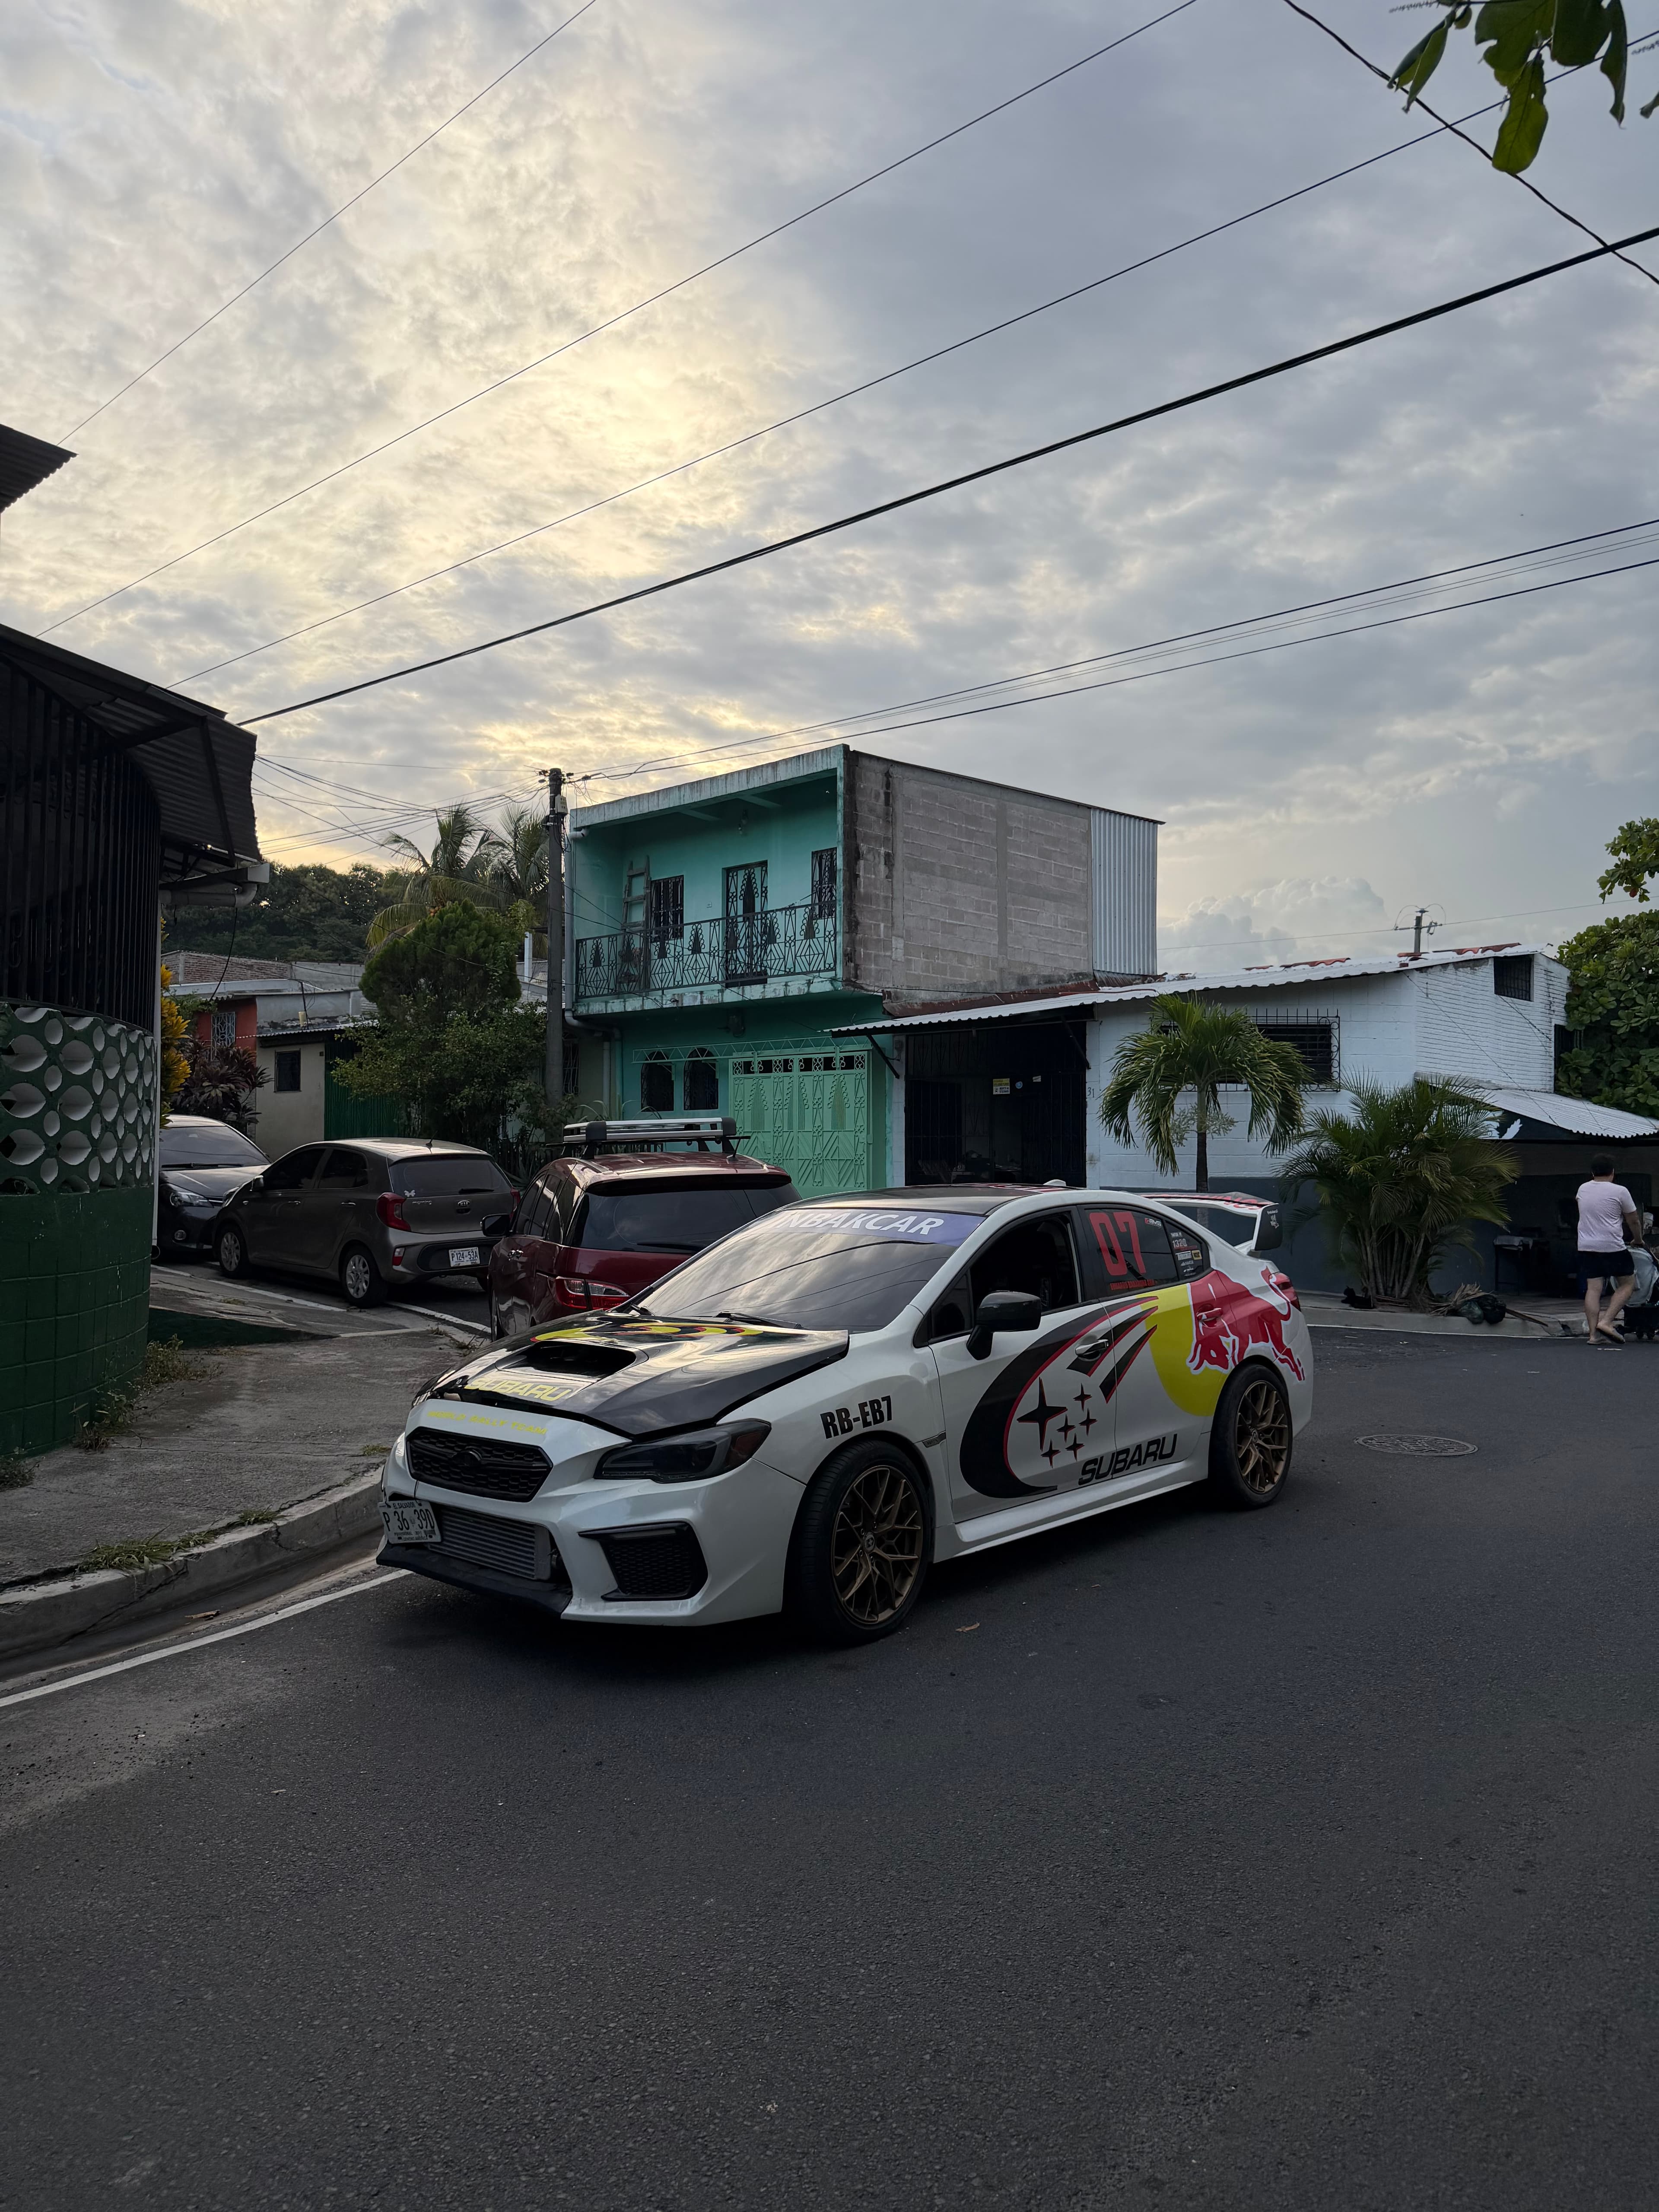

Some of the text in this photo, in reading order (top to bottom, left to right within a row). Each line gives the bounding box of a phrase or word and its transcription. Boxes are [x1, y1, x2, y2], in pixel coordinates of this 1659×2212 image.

[1087, 1087, 1095, 1098] 31
[1089, 1211, 1146, 1276] 07
[451, 1251, 478, 1261] P 124 53A
[464, 1377, 572, 1402] SUBARU
[469, 1414, 509, 1427] RALLY
[511, 1421, 548, 1435] TEAM
[820, 1395, 892, 1440] RB-EB7
[1078, 1433, 1178, 1485] SUBARU
[382, 1512, 391, 1532] P
[394, 1510, 410, 1531] 36
